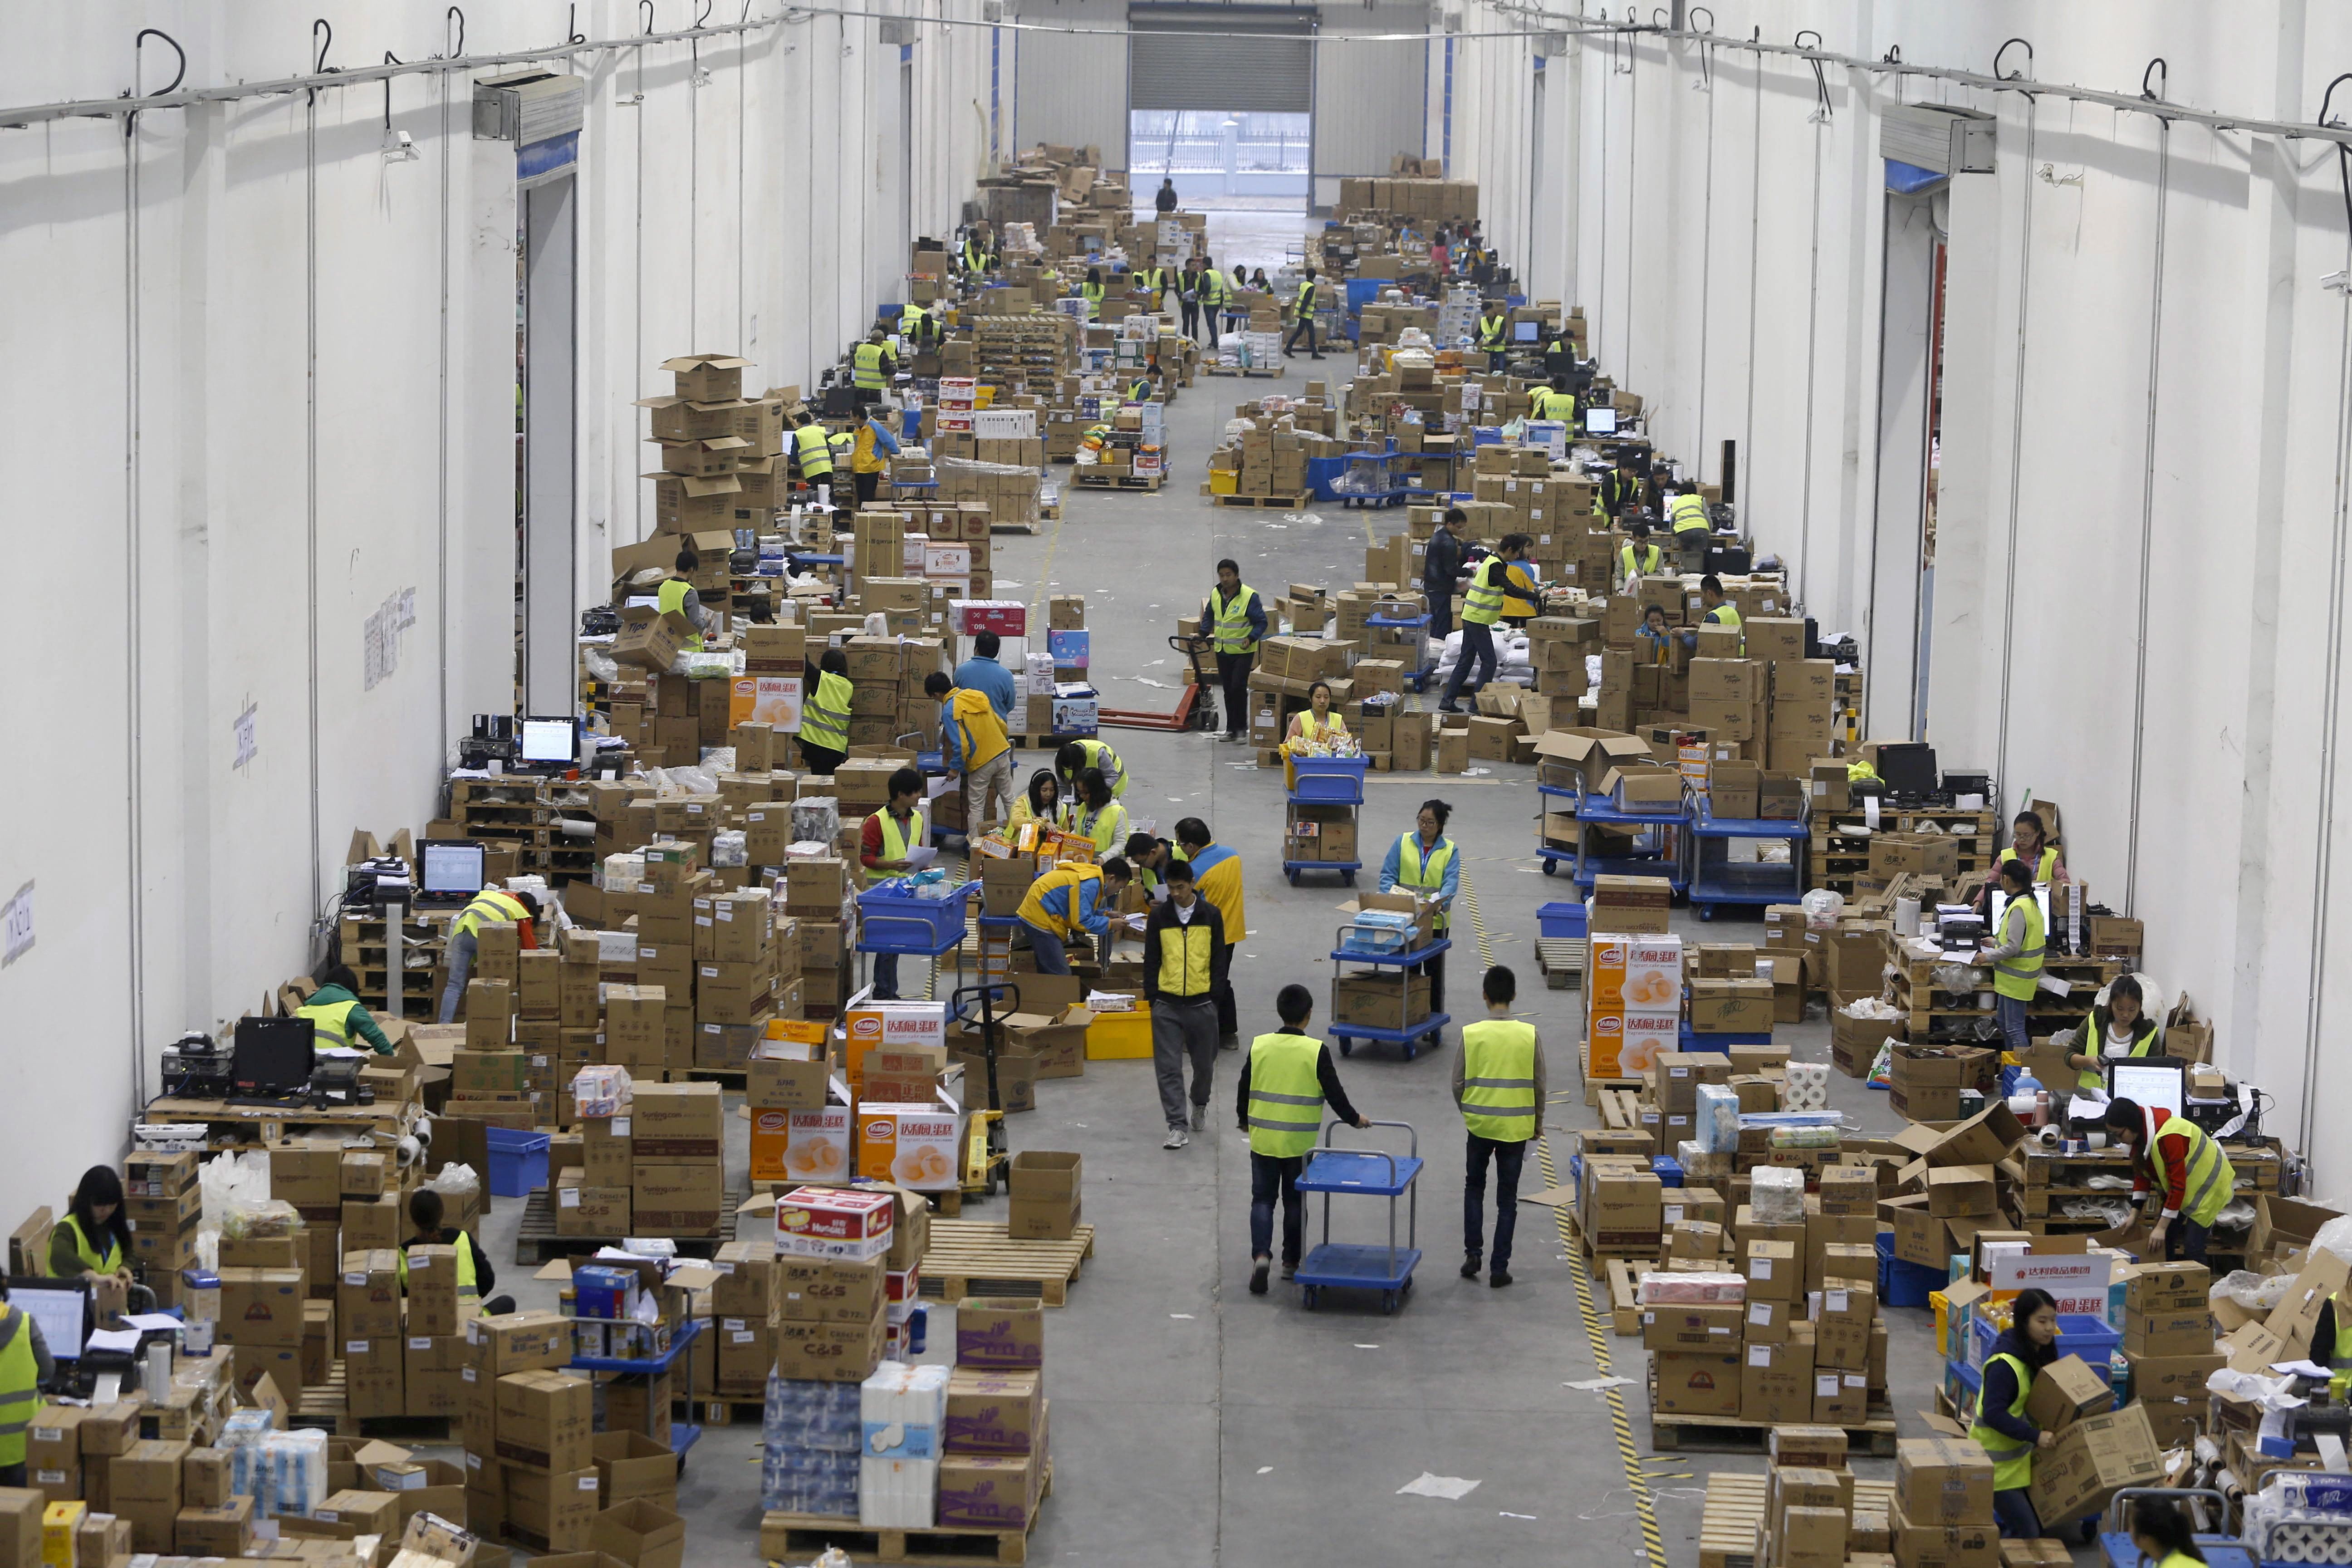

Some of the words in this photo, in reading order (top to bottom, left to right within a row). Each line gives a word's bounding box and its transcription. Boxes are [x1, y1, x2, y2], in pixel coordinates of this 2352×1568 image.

[628, 622, 647, 633] Tipo
[1717, 1000, 1751, 1018] 清风
[642, 1111, 682, 1120] Suning.com
[642, 1186, 682, 1194] Suning.com
[577, 1206, 609, 1215] C&S
[2028, 1266, 2091, 1275] 达利食品集团
[807, 1285, 846, 1297] C&S
[2204, 1314, 2213, 1330] 3
[542, 1343, 549, 1355] 3
[804, 1343, 843, 1356] C&S
